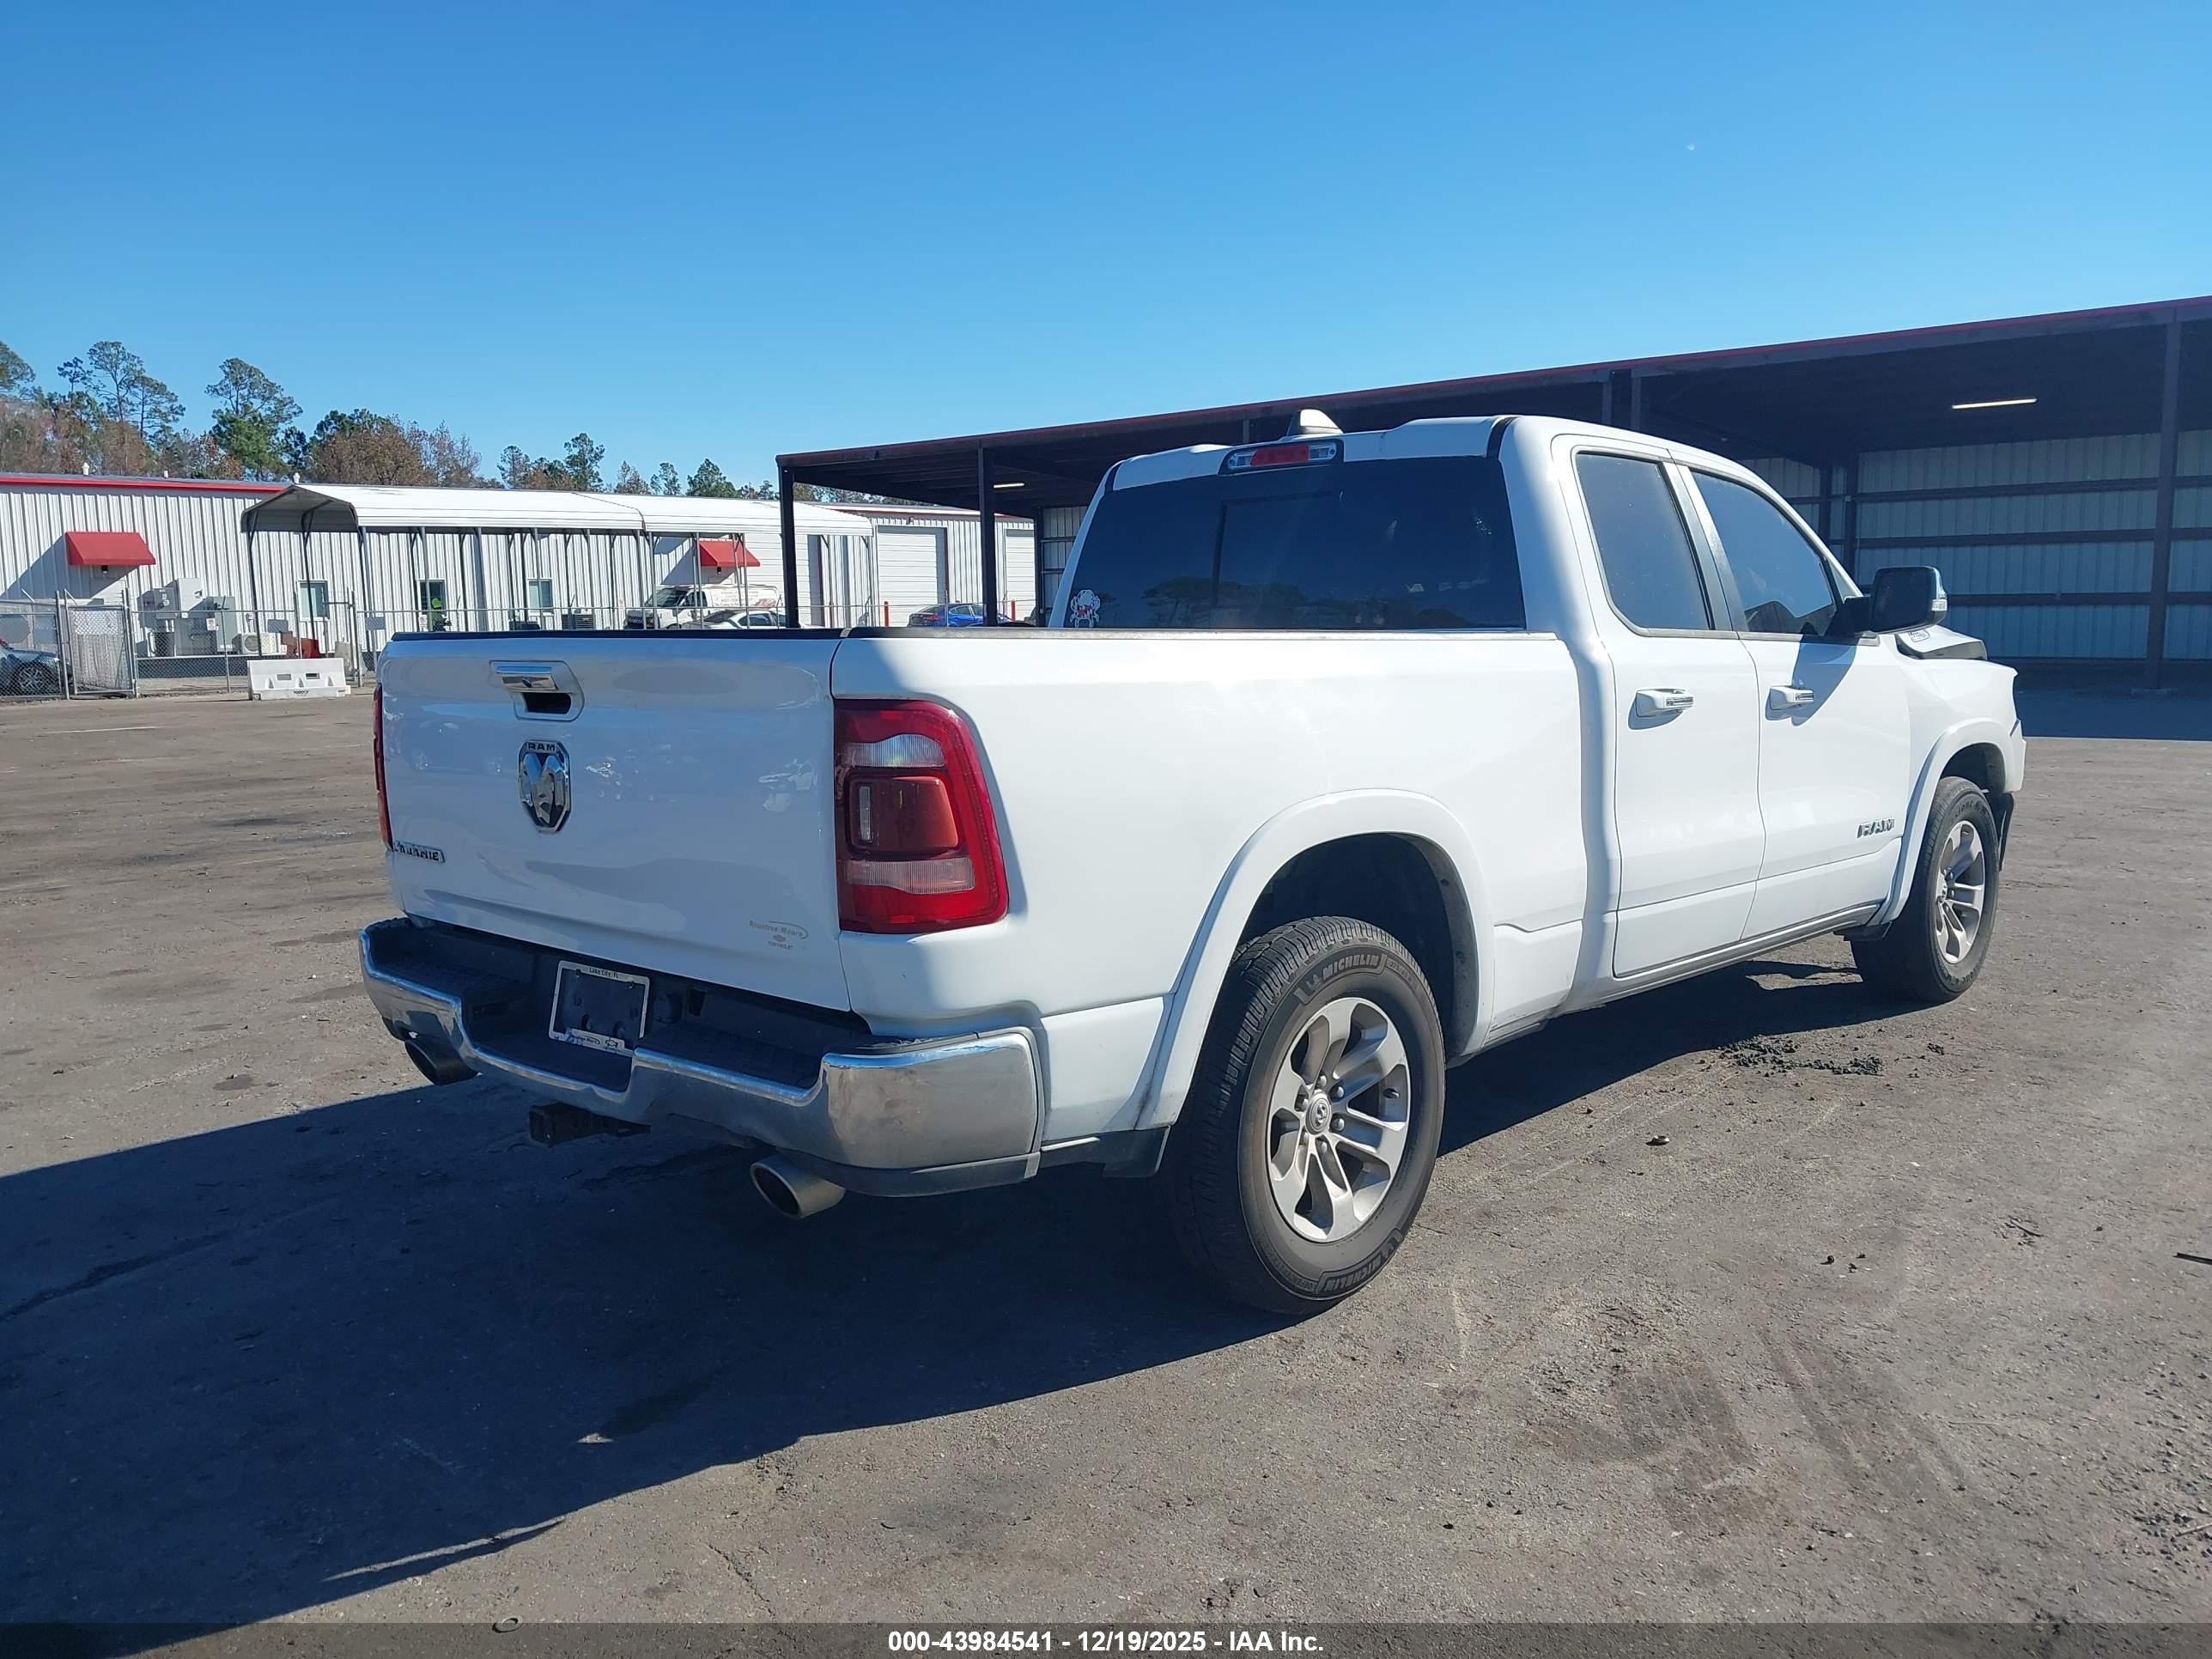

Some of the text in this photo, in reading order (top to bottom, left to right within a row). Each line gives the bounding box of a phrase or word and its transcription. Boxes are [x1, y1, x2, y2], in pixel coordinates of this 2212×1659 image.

[528, 743, 556, 751] RAM
[1856, 818, 1895, 838] RAM
[1322, 953, 1379, 980] MICHELIN
